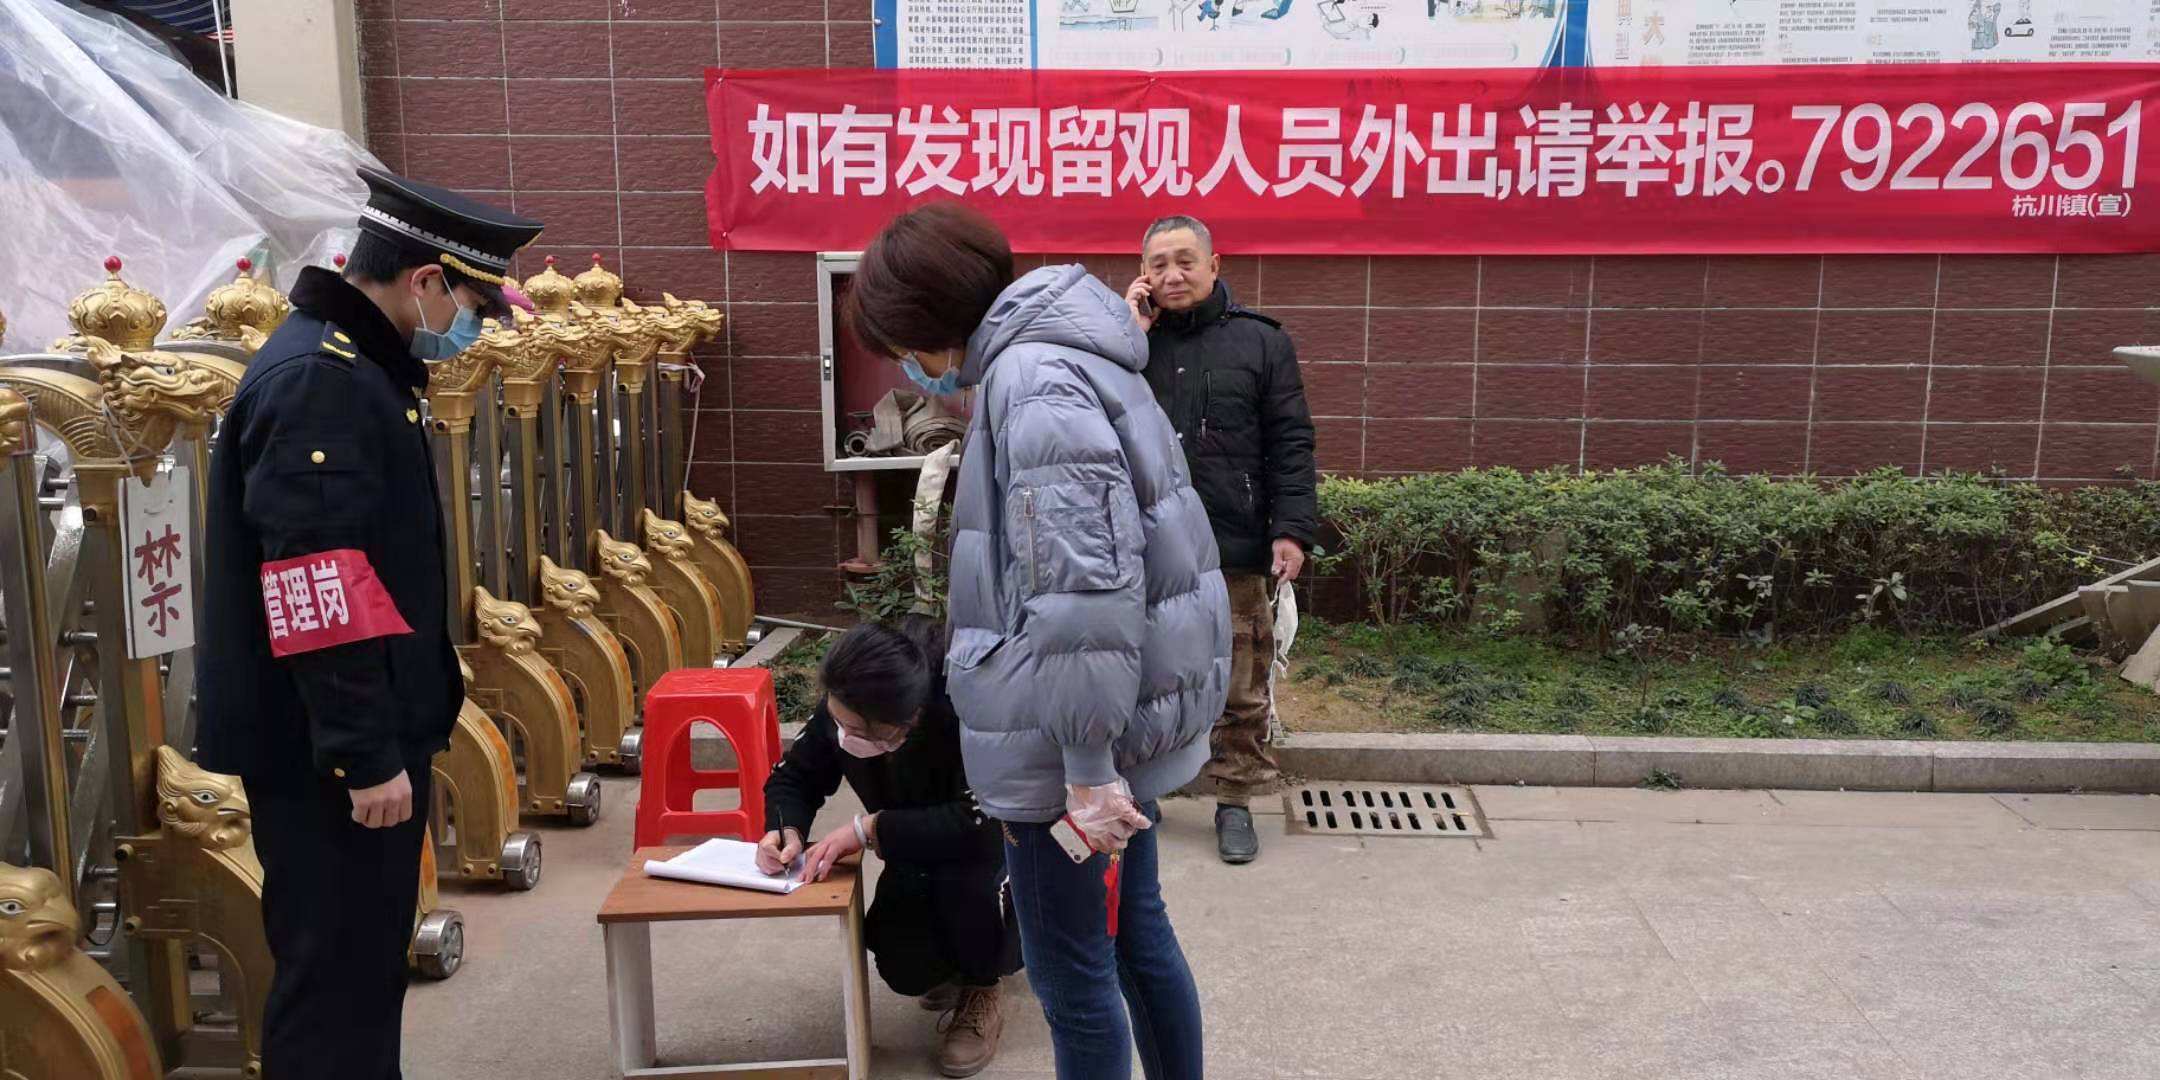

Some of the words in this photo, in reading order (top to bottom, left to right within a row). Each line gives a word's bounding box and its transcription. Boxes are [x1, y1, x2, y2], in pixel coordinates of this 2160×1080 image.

[2011, 192, 2133, 218] 杭川镇(宣)
[261, 559, 350, 640] 管理岗
